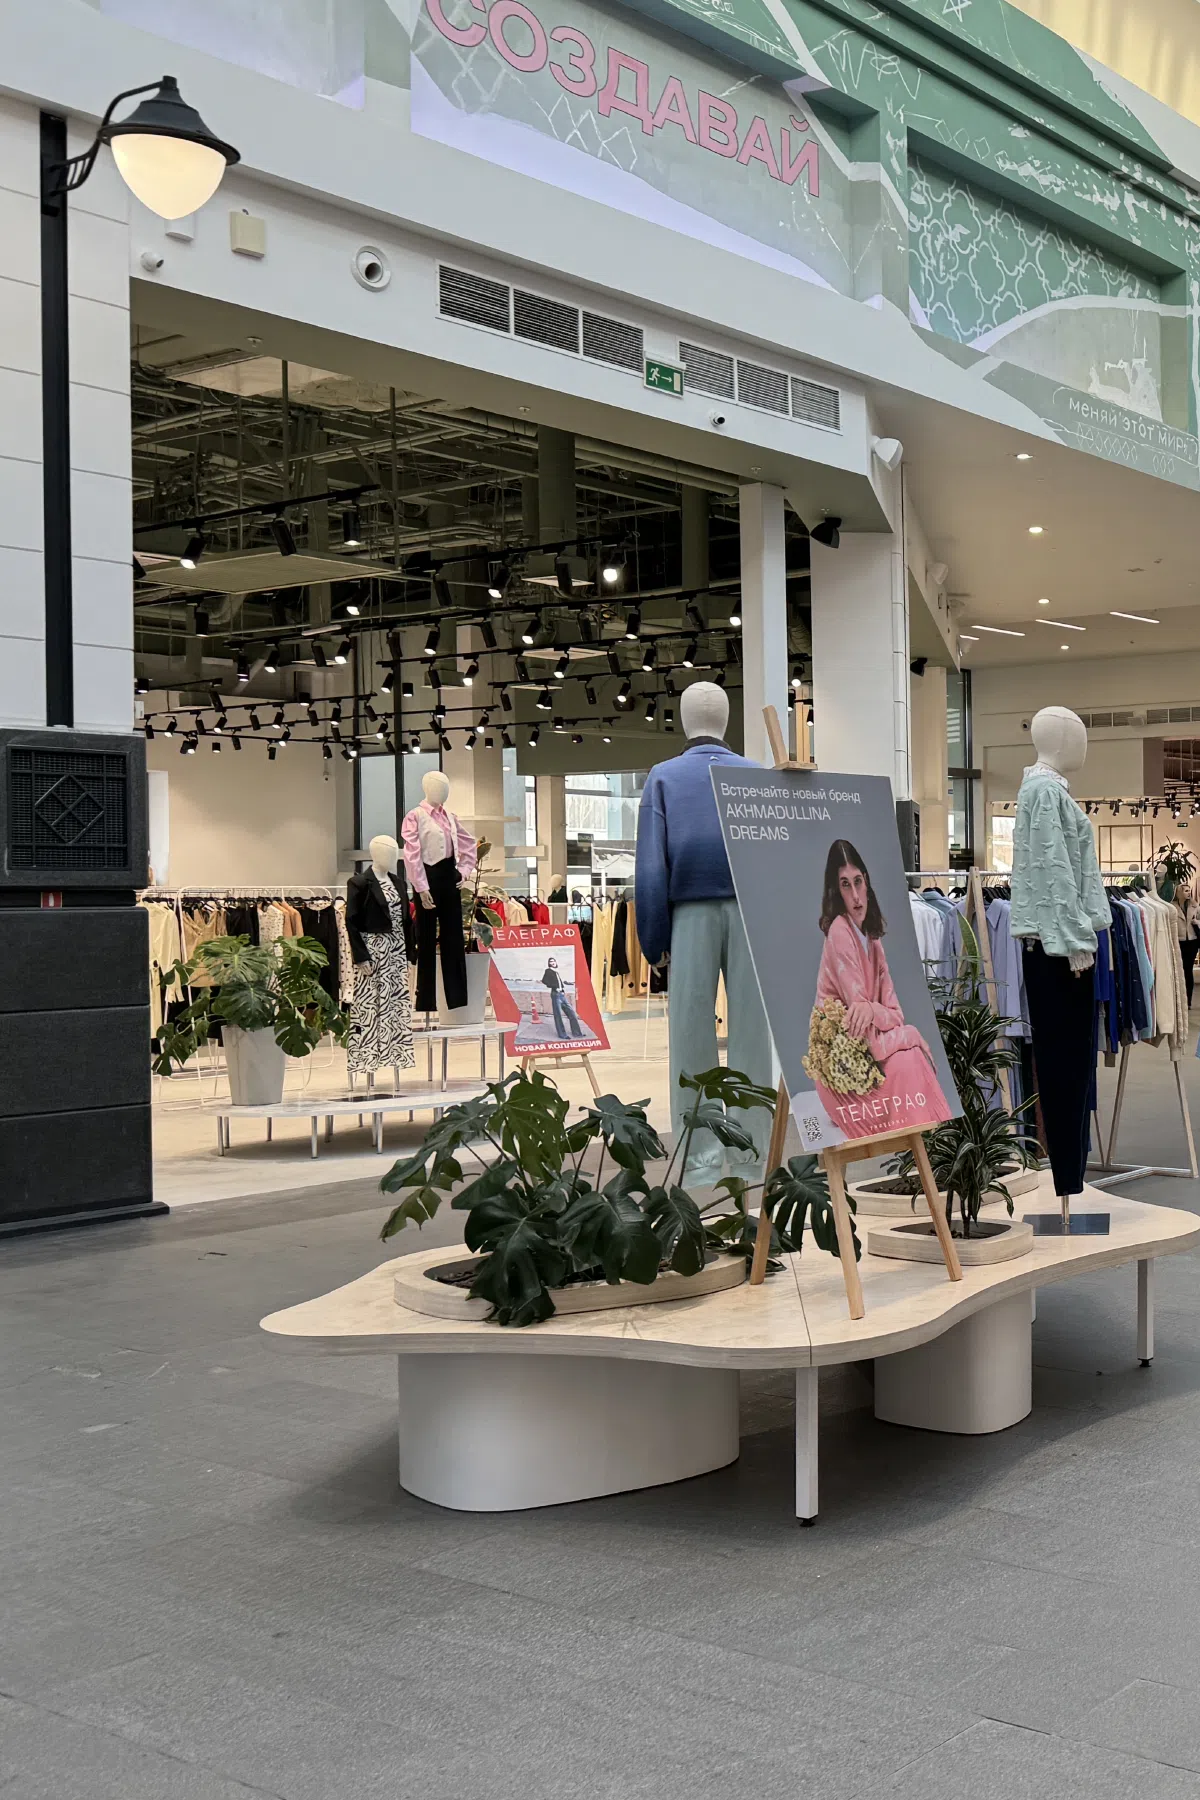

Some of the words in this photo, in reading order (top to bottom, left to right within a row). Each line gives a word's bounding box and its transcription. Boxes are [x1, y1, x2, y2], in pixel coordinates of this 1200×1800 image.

[424, 0, 820, 197] СОЗДАВАЙ
[1069, 397, 1117, 426] меняй
[1122, 417, 1154, 440] этот
[721, 783, 790, 799] Встречайте
[792, 788, 827, 800] новый
[830, 789, 861, 804] бренд
[726, 803, 831, 820] AKHMADULLINA
[731, 825, 790, 840] DREAMS
[495, 928, 576, 941] ЕЛЕГРАФ
[514, 1044, 547, 1052] НОВАЯ
[548, 1041, 602, 1050] КОЛЛЕКЦИЯ
[836, 1092, 926, 1123] ТЕЛЕГРАФ
